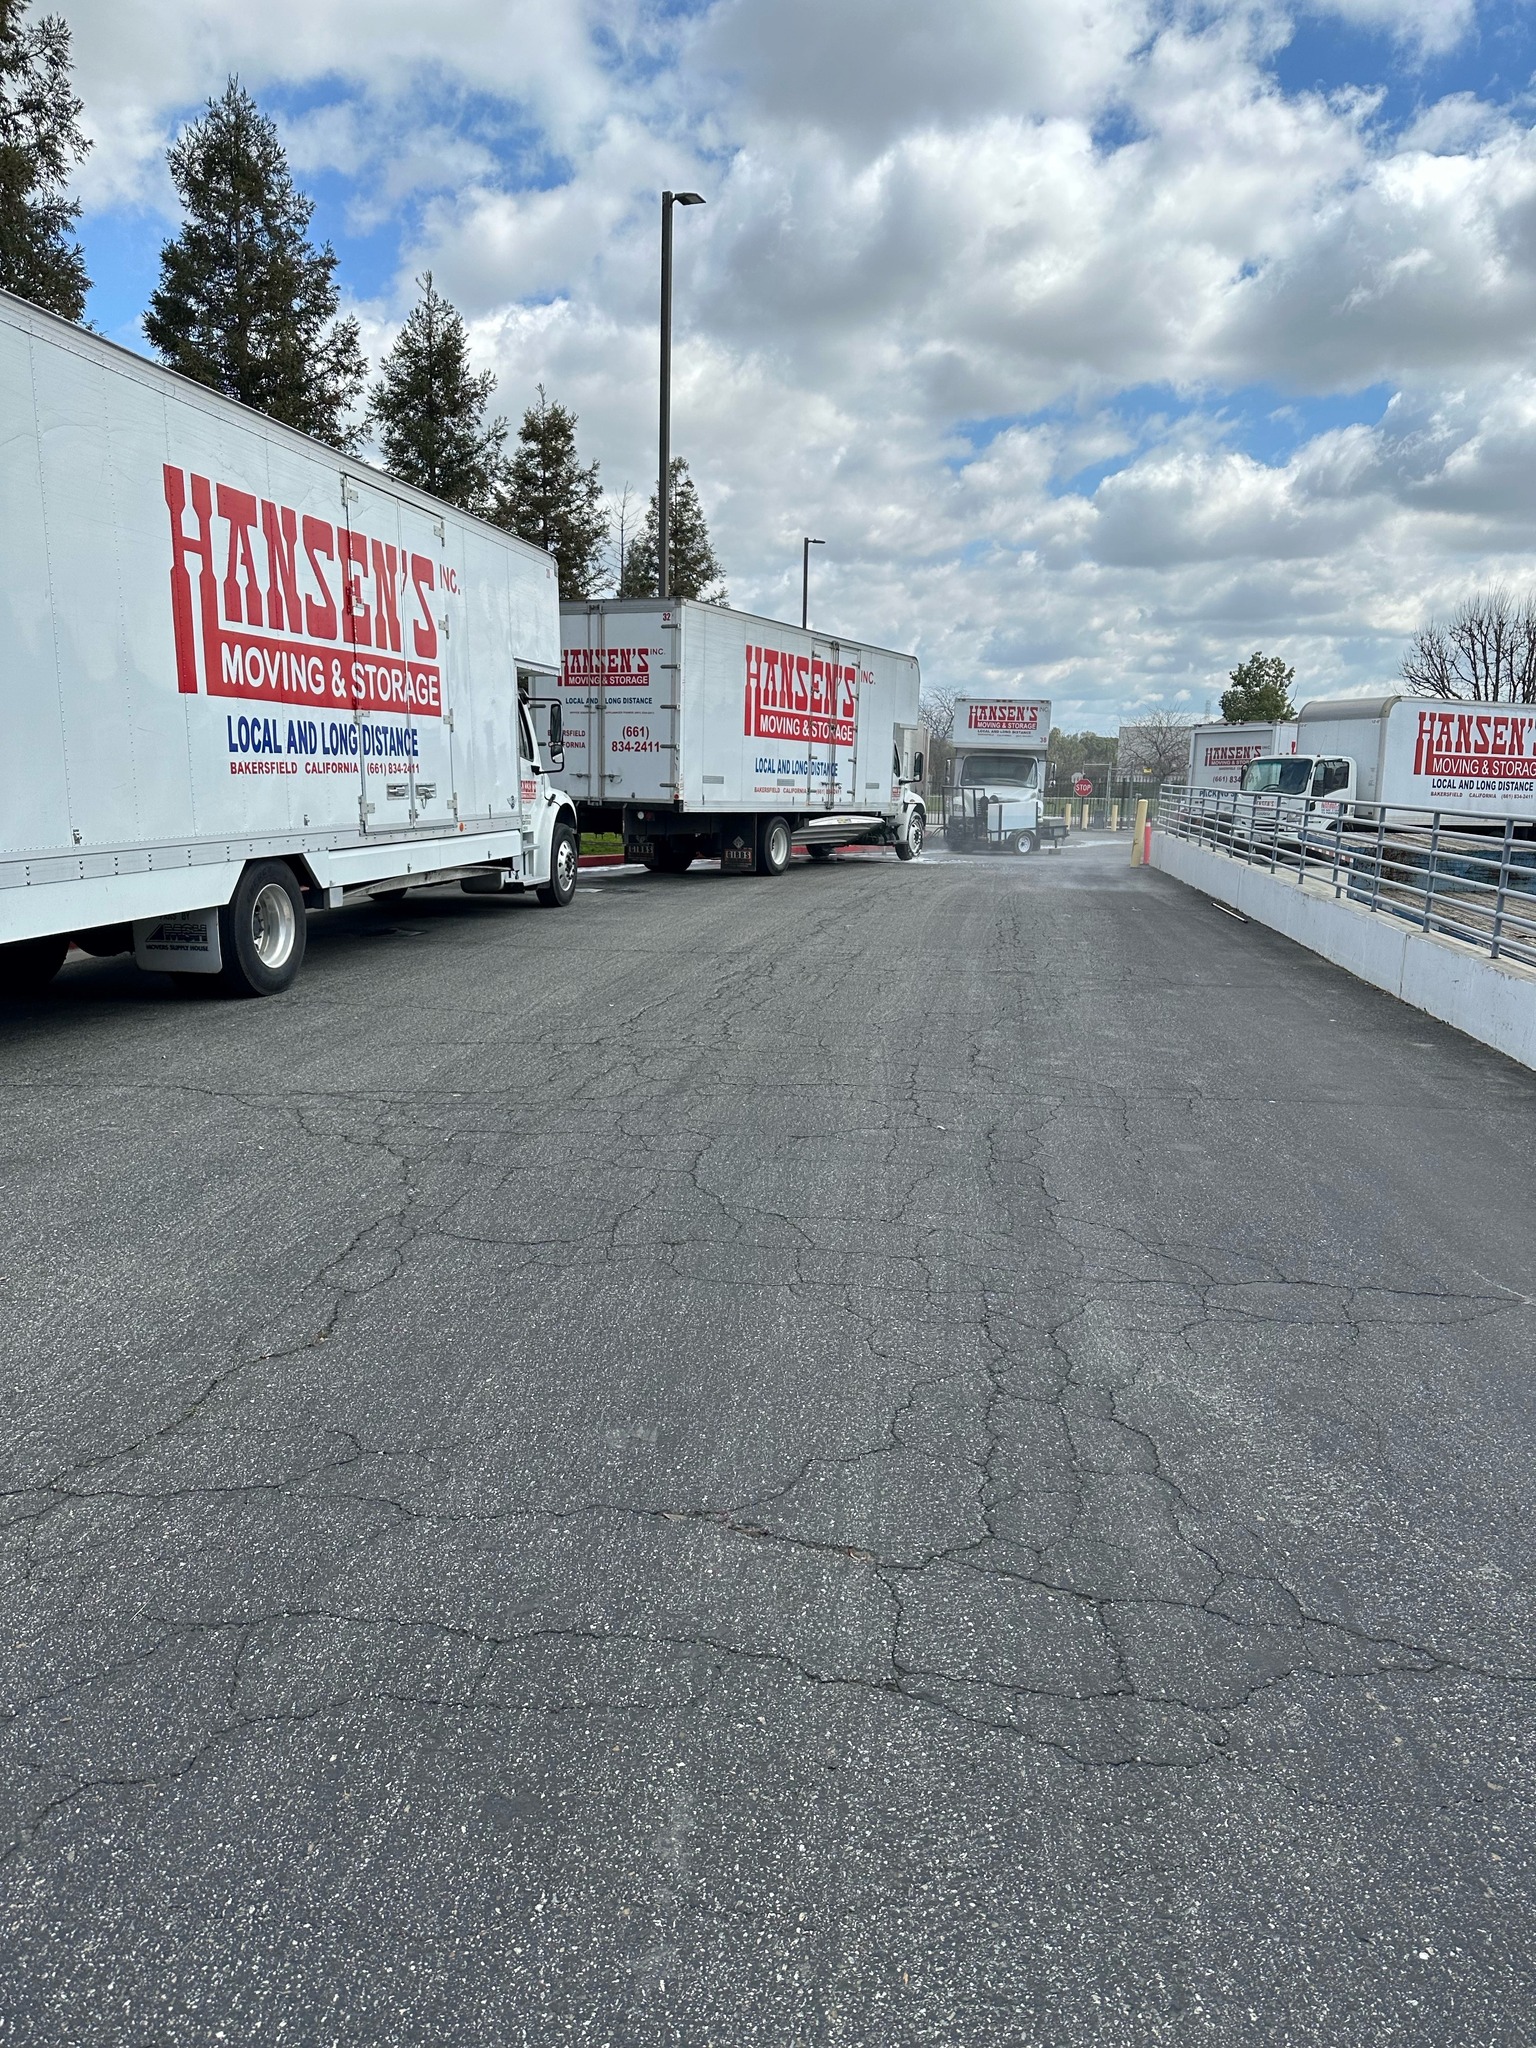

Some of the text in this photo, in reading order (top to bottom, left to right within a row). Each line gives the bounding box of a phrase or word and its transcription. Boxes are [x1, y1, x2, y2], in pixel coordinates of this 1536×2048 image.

[163, 463, 438, 694] HANSEN'S
[439, 564, 461, 595] INC.
[662, 612, 671, 622] 32
[649, 648, 666, 656] INC.
[221, 641, 439, 706] MOVING & STORAGE
[568, 675, 648, 685] MOVING & STORAGE
[860, 670, 876, 685] INC.
[744, 644, 856, 737] HANSEN'S
[565, 697, 653, 705] LOCAL AND LONG DISTANCE
[968, 705, 1039, 729] HANSEN'S
[977, 721, 1000, 729] MOVING
[1007, 722, 1037, 730] STORAGE
[227, 715, 419, 757] LOCAL AND LONG DISTANCE
[622, 726, 650, 741] (661)
[760, 714, 853, 742] MOVING & STORAGE
[611, 741, 660, 753] 834-2411
[1413, 711, 1536, 775] HANSEN'
[1204, 746, 1262, 767] HANSEN'S
[230, 761, 420, 777] BAKERSFIELD CALIFORNIA (661) 834-2411
[755, 757, 775, 774] LOCAL
[777, 758, 791, 775] AND
[791, 760, 808, 776] LONG
[1432, 757, 1536, 777] MOVING & STORAG
[1075, 783, 1091, 792] STOP
[1432, 778, 1534, 792] LOCAL AND LONG DISTANCE
